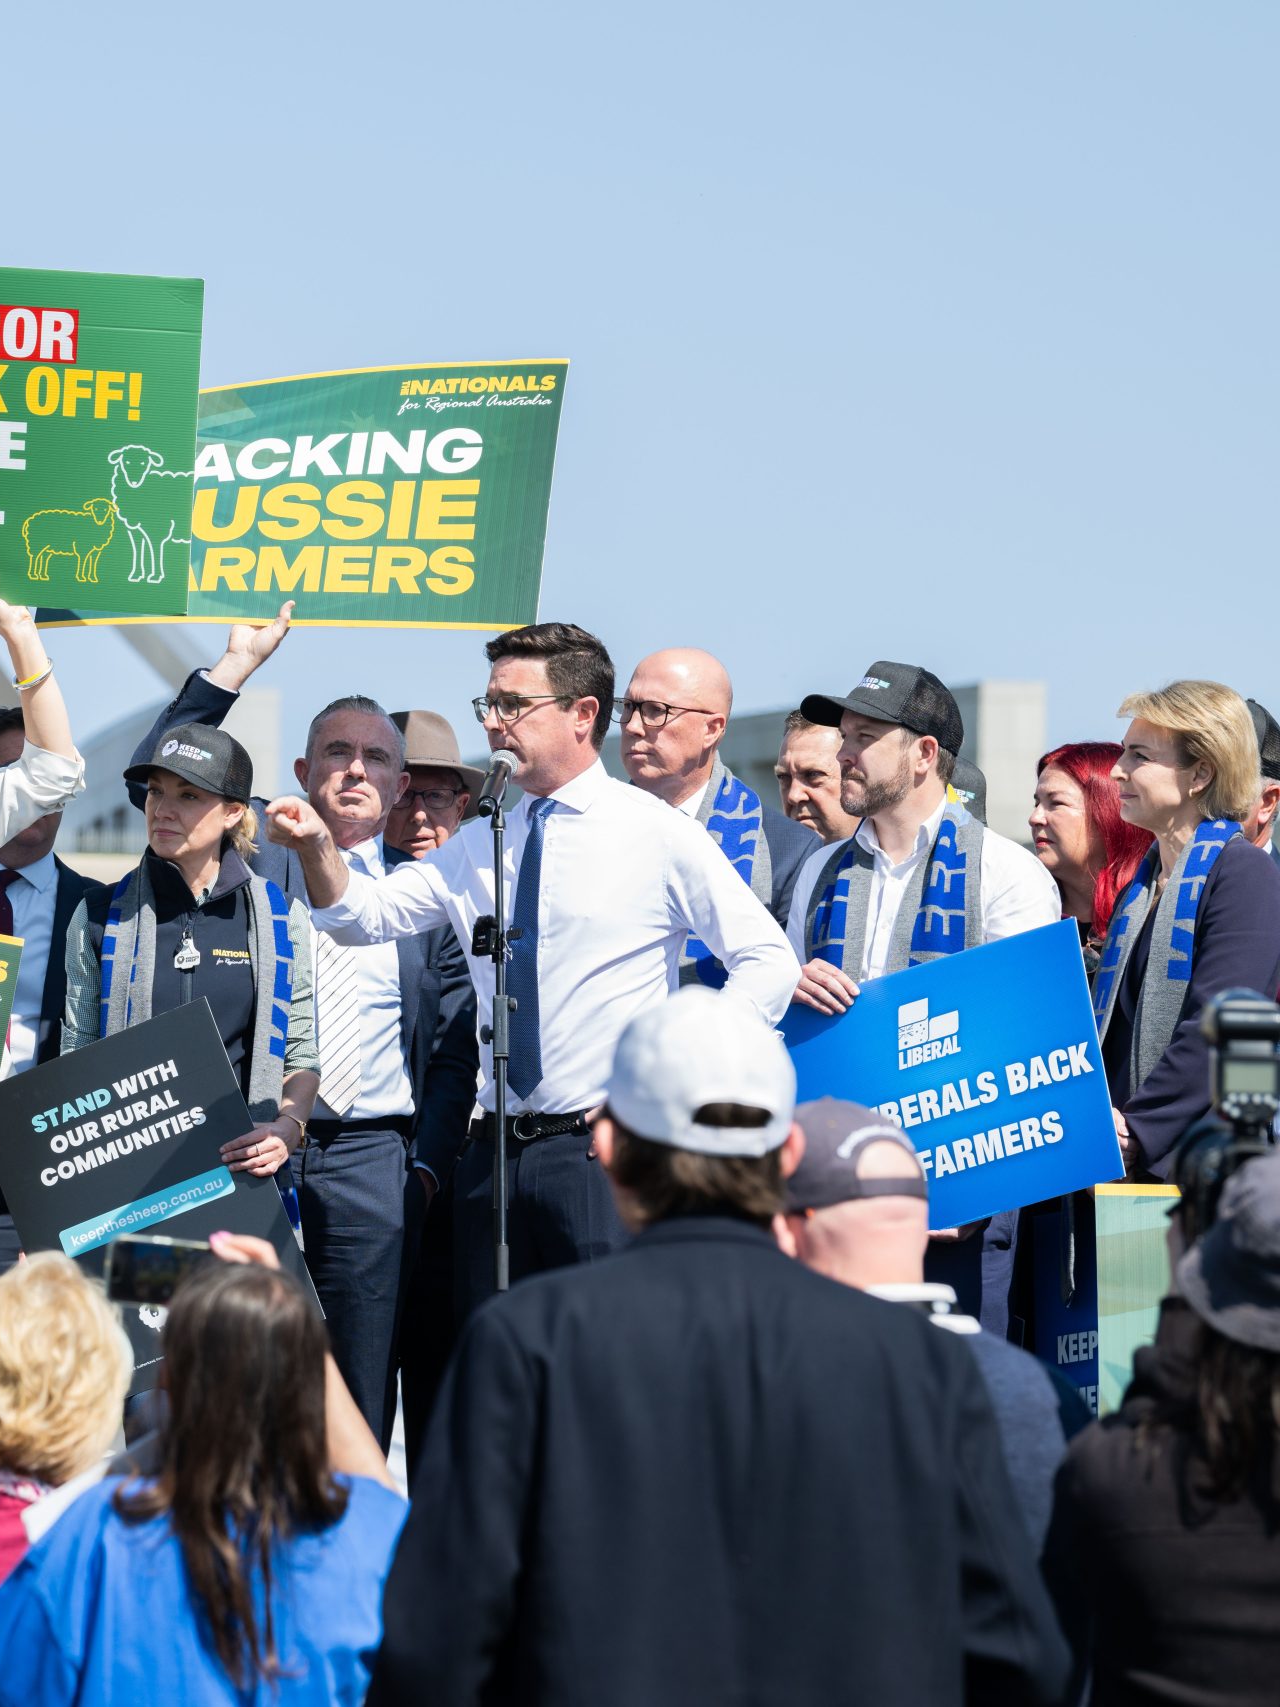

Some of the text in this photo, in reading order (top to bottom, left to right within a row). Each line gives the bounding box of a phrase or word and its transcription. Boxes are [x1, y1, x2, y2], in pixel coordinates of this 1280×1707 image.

[25, 366, 143, 421] OFF!
[397, 393, 552, 416] for Regional Australia
[409, 375, 557, 395] NATIONALS
[193, 427, 484, 485] ACKING
[191, 479, 481, 543] USSIE
[177, 749, 203, 761] SHEEP
[179, 743, 201, 754] KEEP
[898, 1035, 961, 1071] LIBERAL
[30, 1059, 180, 1133] STAND WITH
[870, 1041, 1095, 1129] BERALS BACK
[39, 1105, 207, 1188] COMMUNITIES
[49, 1090, 180, 1154] OUR RURAL
[69, 1175, 225, 1249] keepthesheep.com.au
[1057, 1330, 1098, 1365] KEEP
